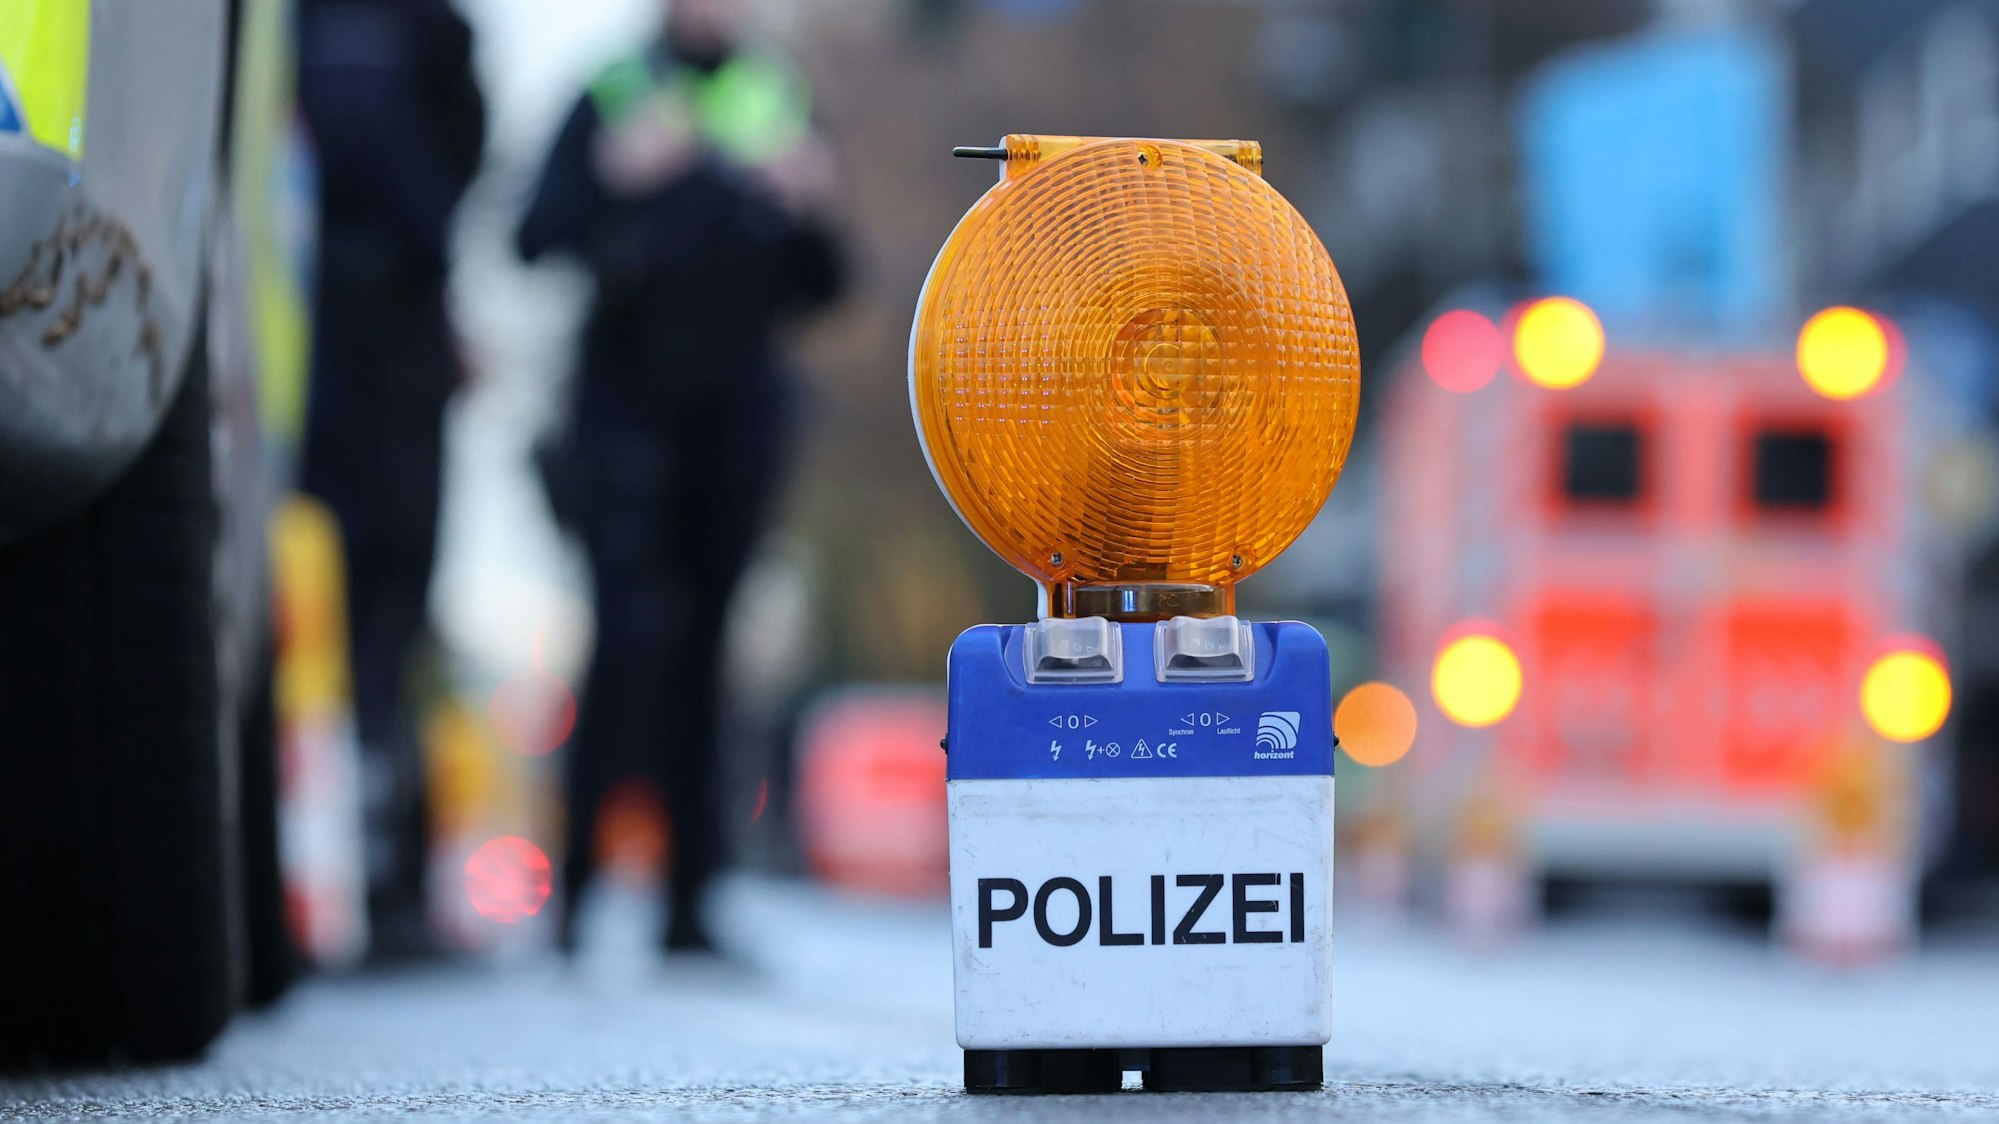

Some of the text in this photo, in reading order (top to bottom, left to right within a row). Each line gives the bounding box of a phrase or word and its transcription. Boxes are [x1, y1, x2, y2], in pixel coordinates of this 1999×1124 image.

[1168, 728, 1194, 737] Synchron
[1216, 727, 1241, 735] Lauflicht
[1156, 742, 1177, 759] CE
[1254, 750, 1295, 760] horizont
[977, 872, 1305, 948] POLIZEI
